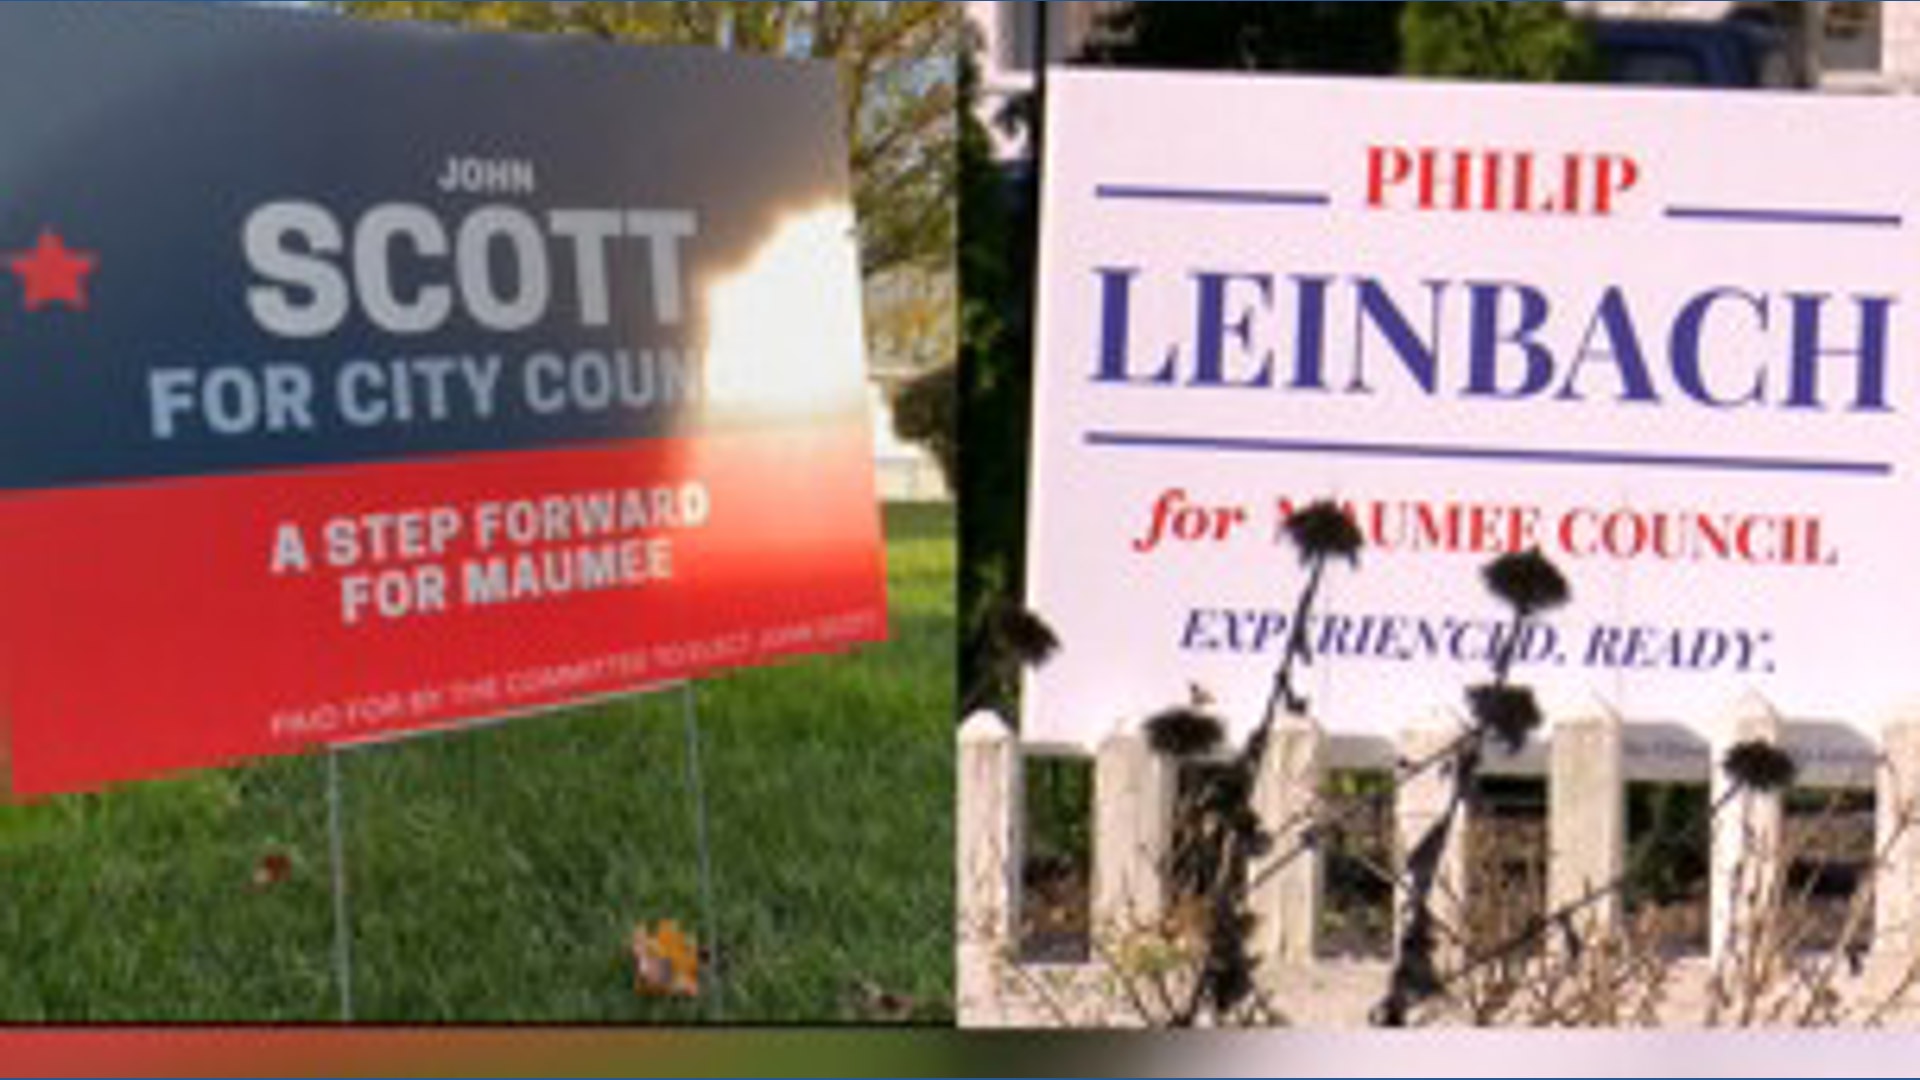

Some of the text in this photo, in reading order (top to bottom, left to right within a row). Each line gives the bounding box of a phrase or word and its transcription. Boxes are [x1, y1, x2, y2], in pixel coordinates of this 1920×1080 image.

[437, 158, 536, 194] JOHN
[1365, 145, 1639, 217] PHILIP
[242, 200, 698, 337] SCOTT
[1089, 266, 1899, 414] LEINBACH
[149, 367, 314, 439] FOR
[337, 354, 501, 427] CITY
[271, 480, 709, 574] A STEP FORWARD
[1133, 488, 1246, 553] for
[1558, 507, 1838, 566] COUNCIL
[342, 538, 674, 626] FOR MAUMEE
[1584, 624, 1776, 674] READY.
